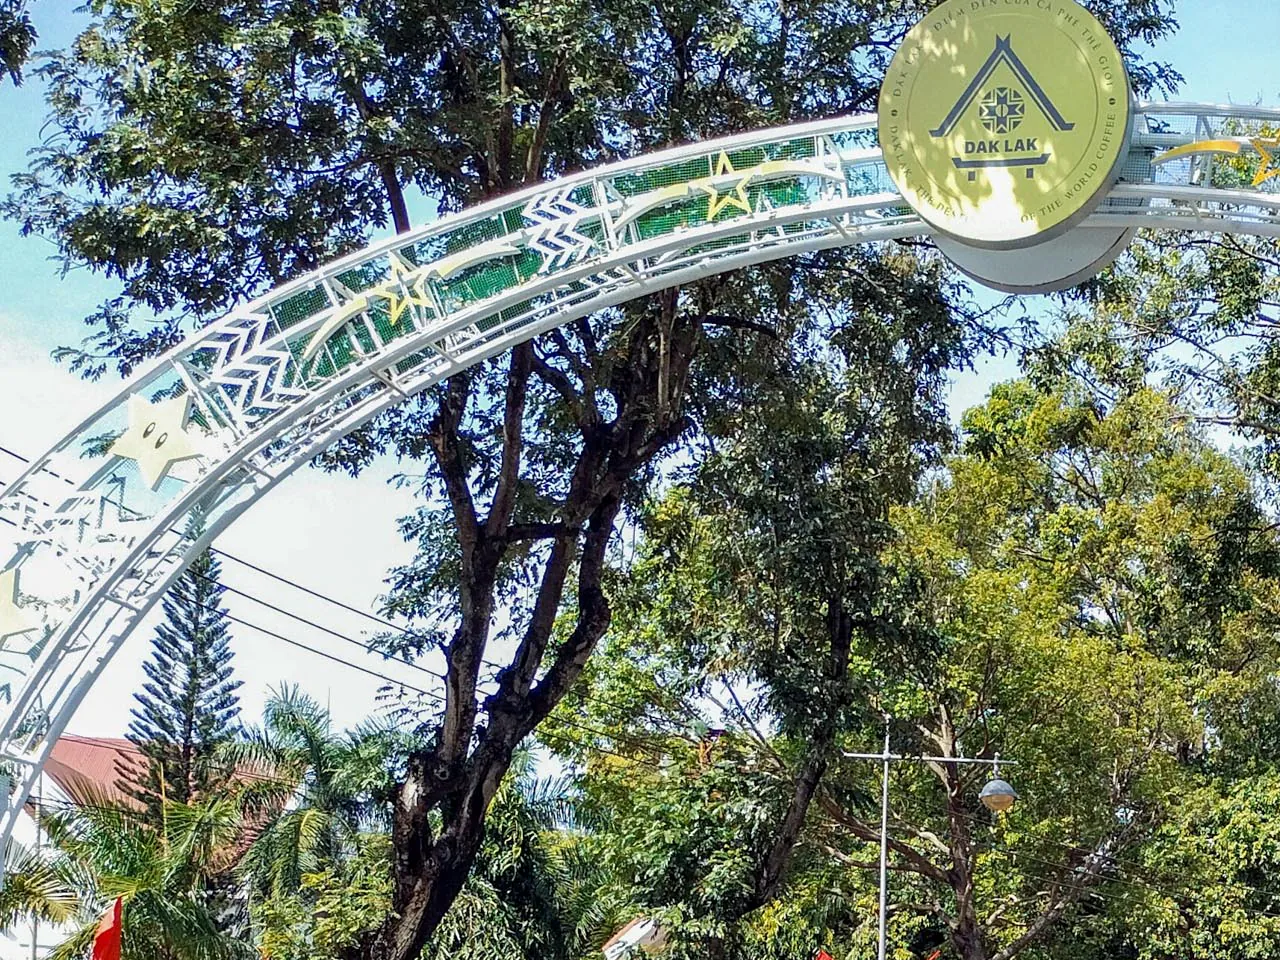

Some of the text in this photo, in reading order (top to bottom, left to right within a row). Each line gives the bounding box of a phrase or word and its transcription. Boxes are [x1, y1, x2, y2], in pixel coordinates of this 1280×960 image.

[965, 137, 1038, 154] DAK LAK
[1039, 199, 1063, 216] THE
[1064, 162, 1098, 200] WORLD
[1096, 113, 1117, 160] COFFEE
